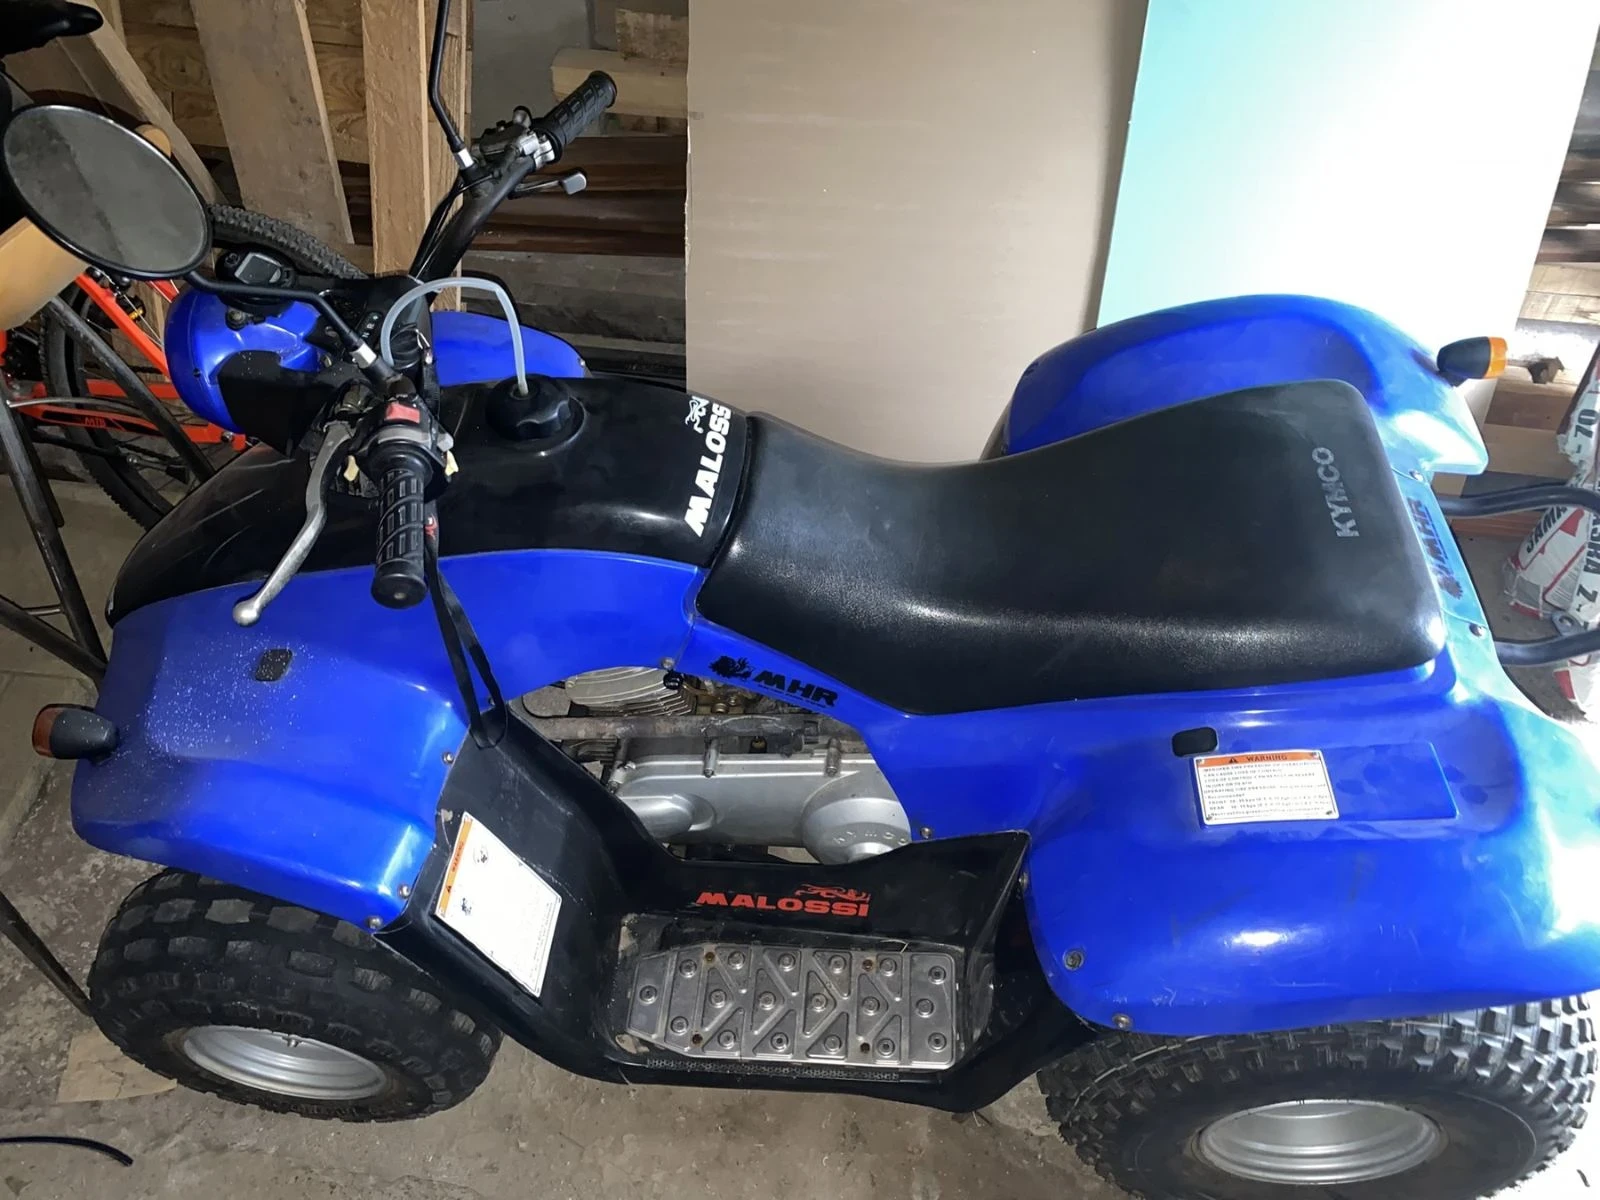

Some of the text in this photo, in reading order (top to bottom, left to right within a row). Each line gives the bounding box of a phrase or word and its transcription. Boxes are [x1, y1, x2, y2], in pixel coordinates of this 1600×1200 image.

[684, 402, 732, 538] MALOSS
[1311, 447, 1360, 538] KYMCO
[753, 670, 839, 707] MHR
[1245, 753, 1288, 763] WARNING
[695, 890, 869, 918] MALOSSI
